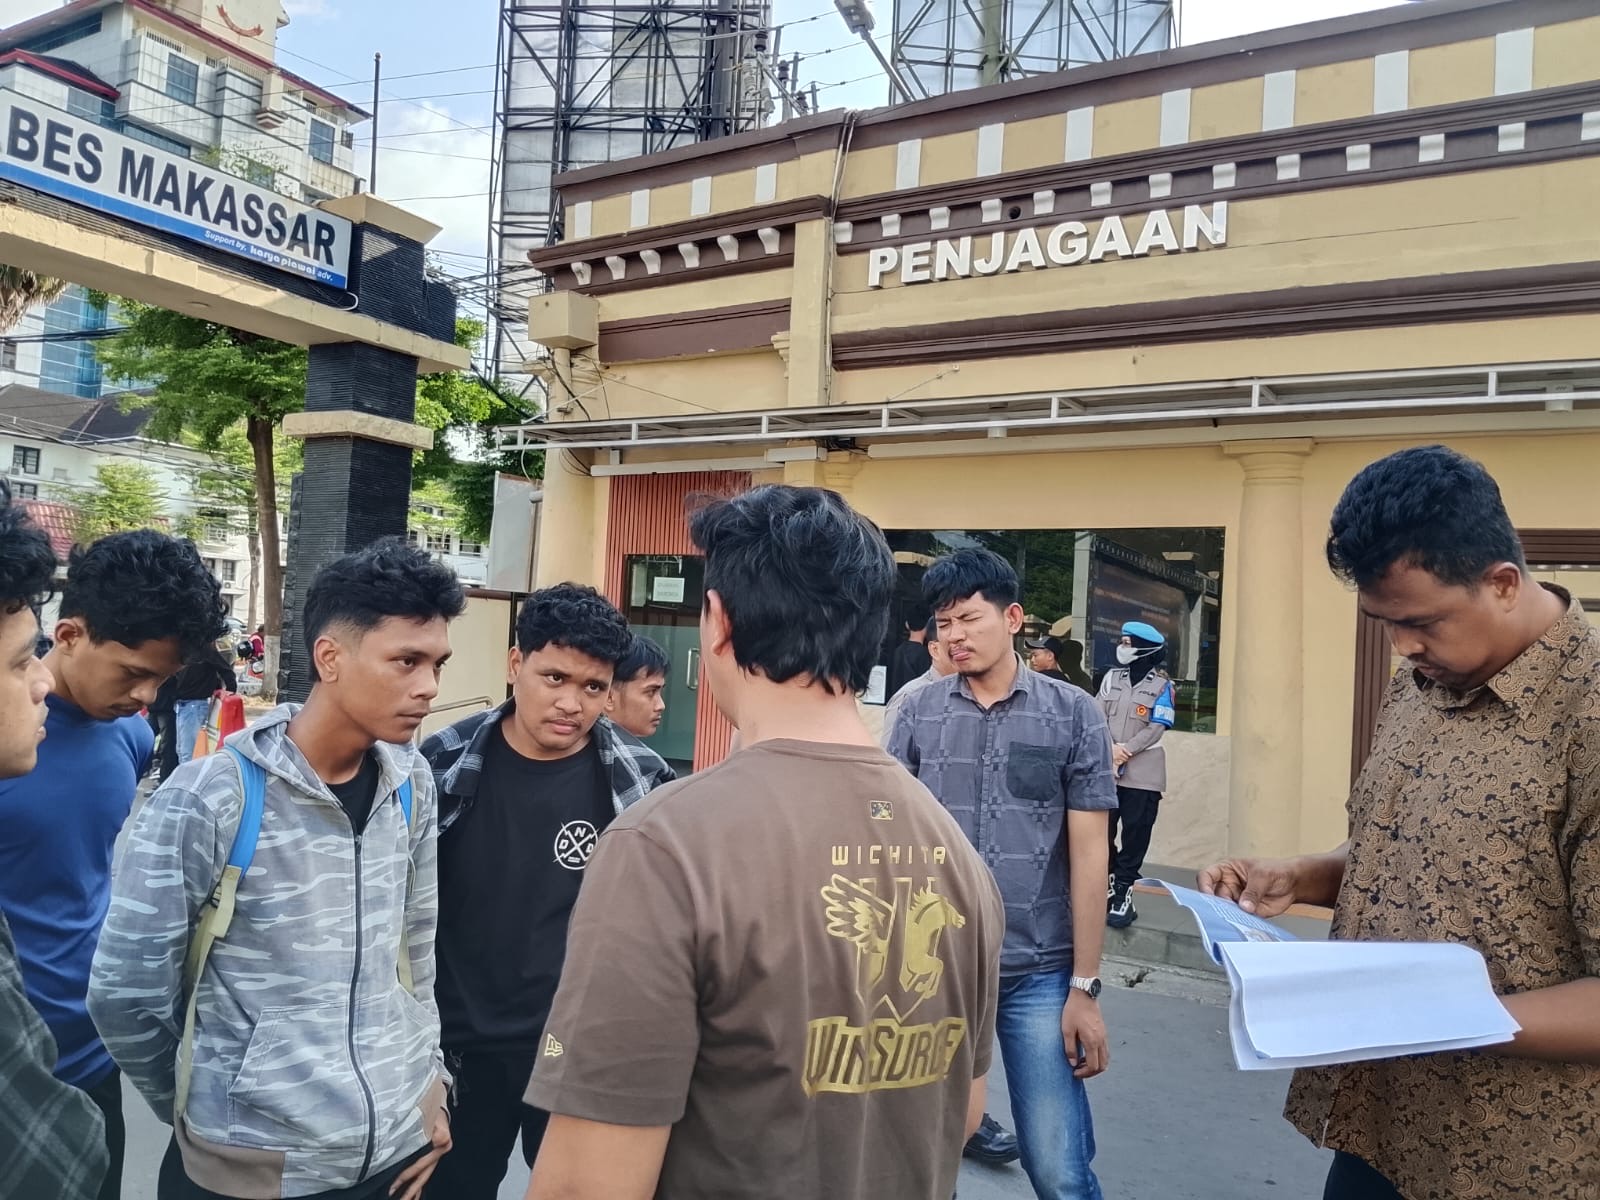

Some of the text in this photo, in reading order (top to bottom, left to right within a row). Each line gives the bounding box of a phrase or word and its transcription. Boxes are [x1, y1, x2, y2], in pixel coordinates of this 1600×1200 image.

[0, 105, 336, 266] BES MAKASSAR
[204, 230, 235, 246] Support
[868, 201, 1228, 288] PENJAGAAN
[832, 845, 947, 866] WICHITA
